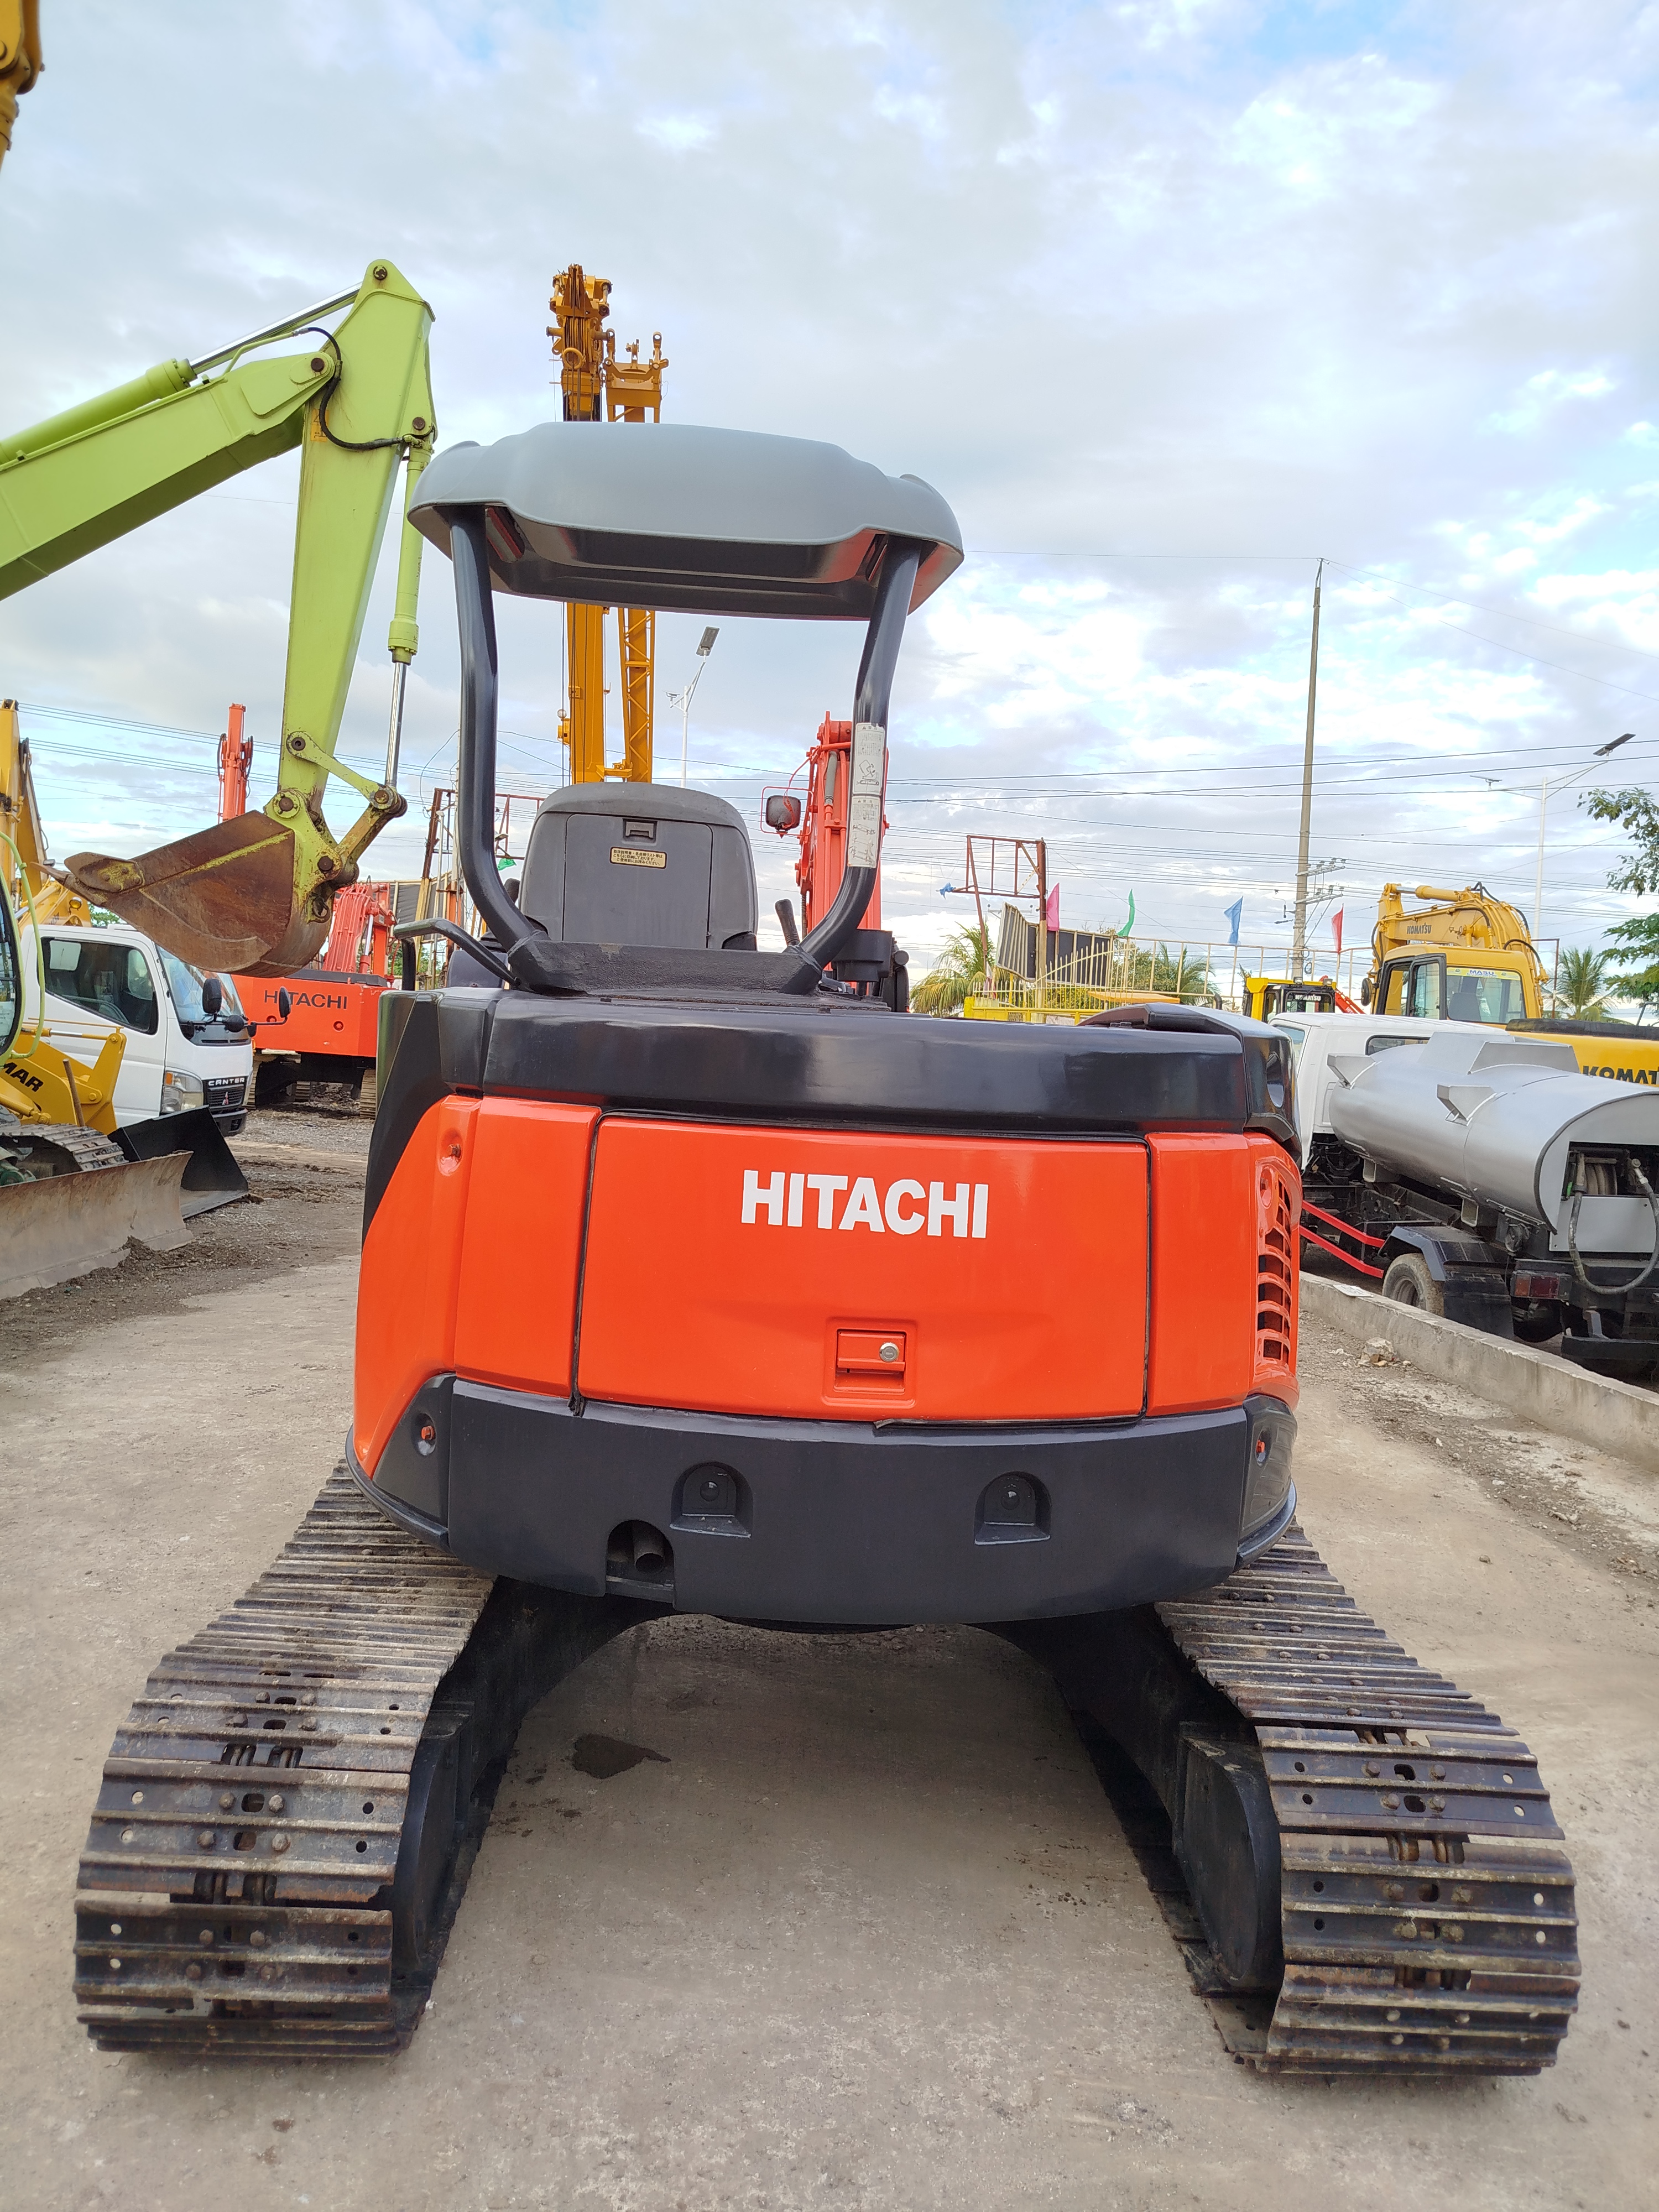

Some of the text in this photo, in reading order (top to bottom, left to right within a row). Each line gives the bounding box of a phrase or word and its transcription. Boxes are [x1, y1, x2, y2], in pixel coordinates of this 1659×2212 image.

[1406, 922, 1432, 934] KOMATSU
[264, 990, 347, 1009] HTACHI
[208, 1077, 245, 1086] CANTER
[742, 1170, 989, 1238] HITACHI
